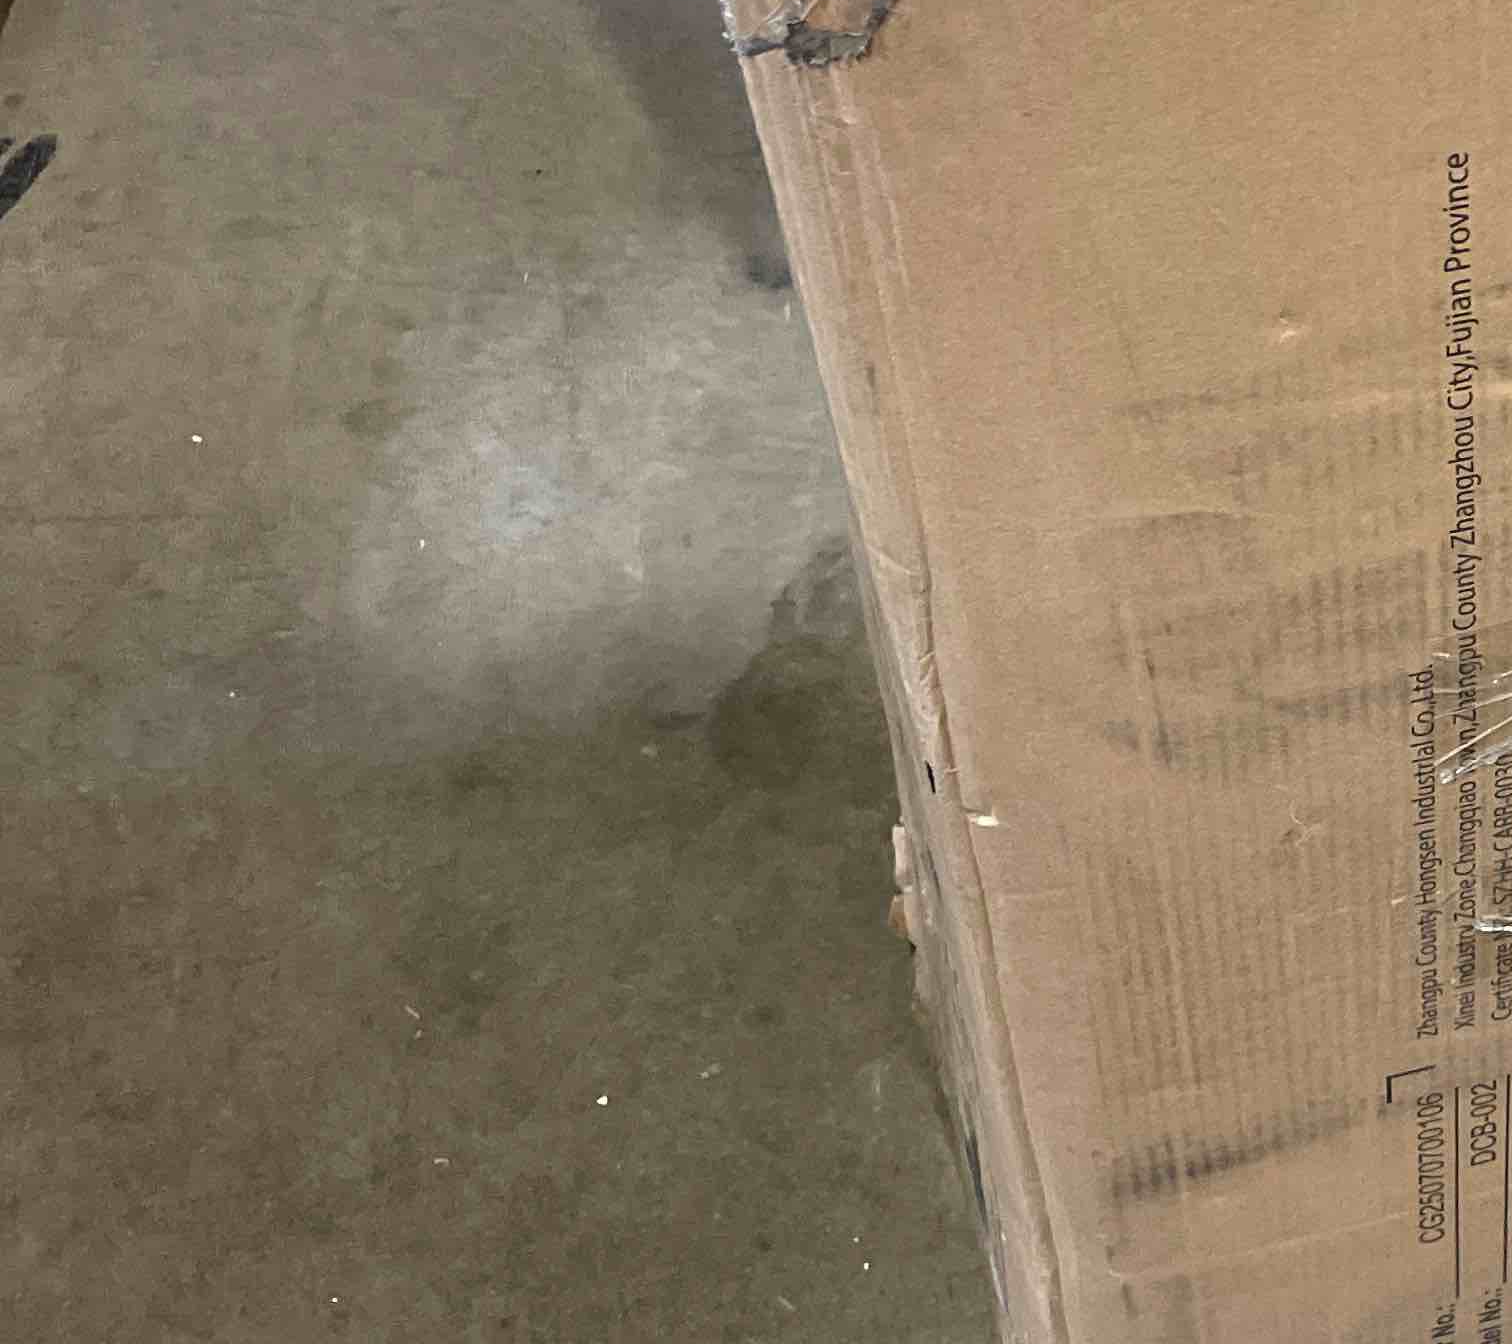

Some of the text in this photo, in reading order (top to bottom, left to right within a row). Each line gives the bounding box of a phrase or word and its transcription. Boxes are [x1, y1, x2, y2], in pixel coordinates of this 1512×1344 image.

[1441, 151, 1472, 271] Province
[1443, 278, 1479, 409] City,Fujian
[1447, 415, 1481, 547] Zhangzhou
[1451, 553, 1482, 629] County
[1413, 828, 1441, 903] Hongsen
[1415, 908, 1442, 965] County
[1453, 924, 1477, 987] Industry
[1416, 968, 1443, 1037] Zhangpu
[1469, 1078, 1498, 1166] DCB-002
[1416, 1090, 1446, 1244] CG25070700106
